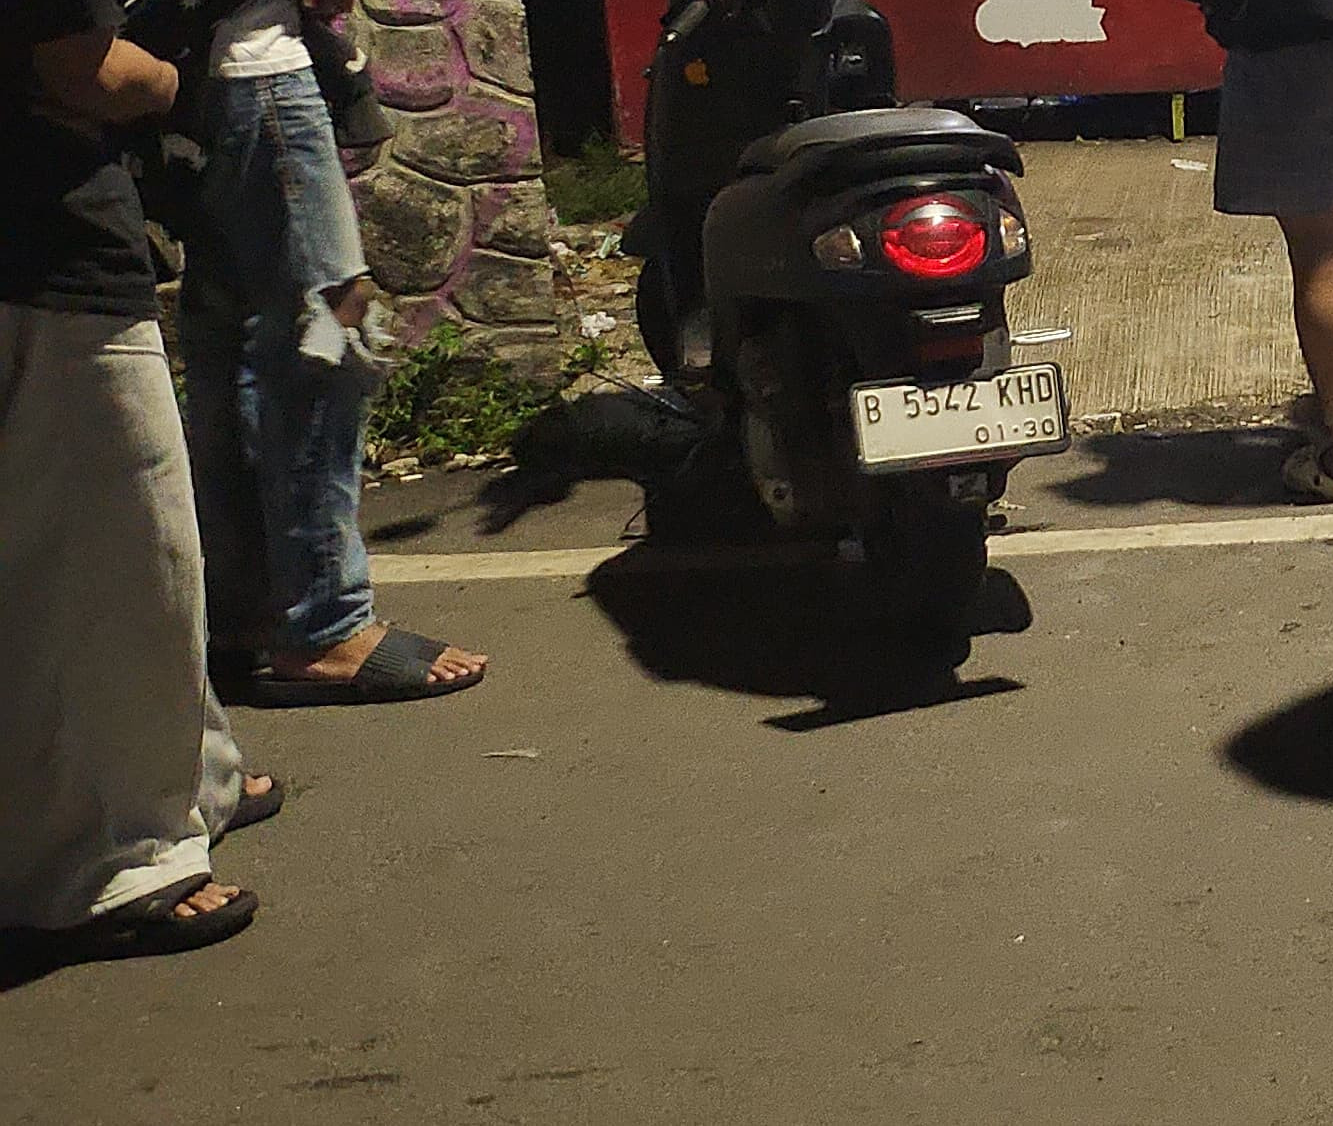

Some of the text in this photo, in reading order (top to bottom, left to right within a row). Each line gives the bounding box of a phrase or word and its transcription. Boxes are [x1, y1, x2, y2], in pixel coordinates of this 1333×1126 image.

[865, 373, 1053, 424] B 5542 KHD
